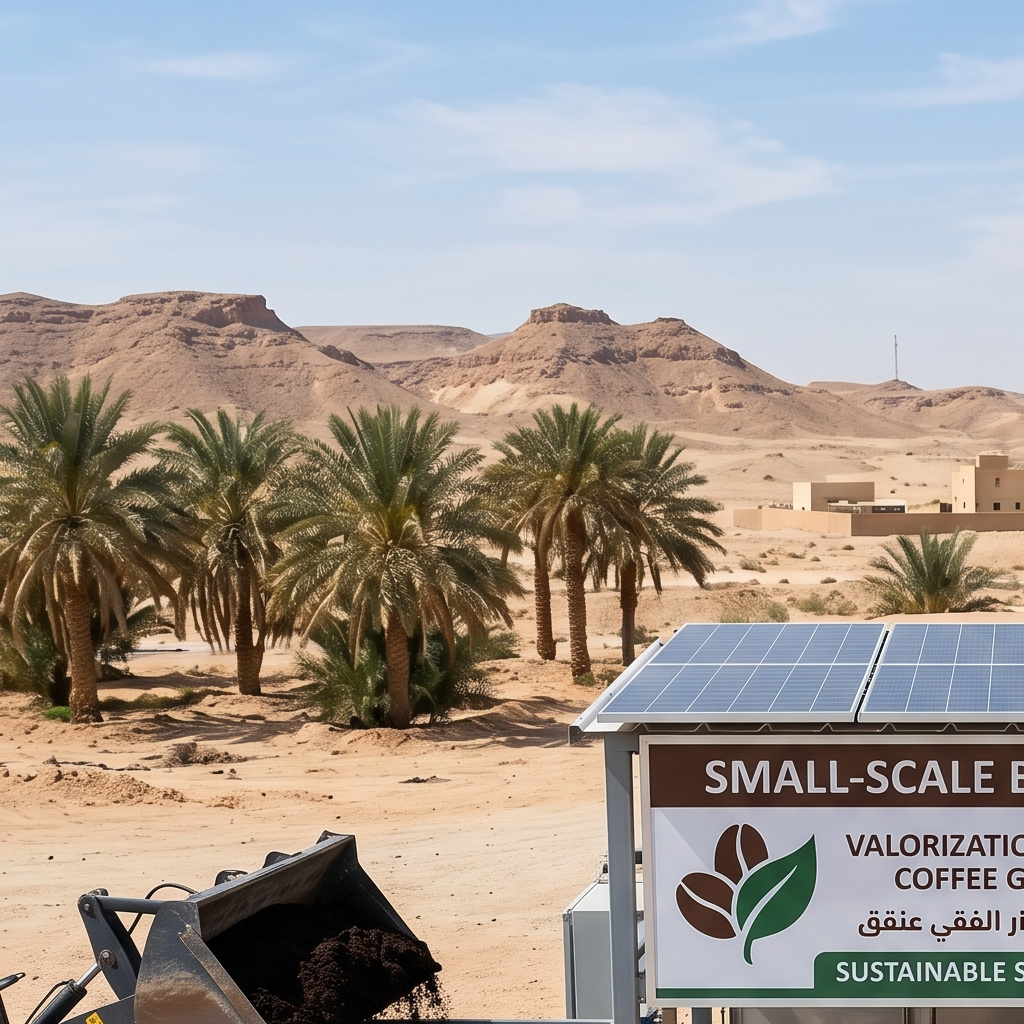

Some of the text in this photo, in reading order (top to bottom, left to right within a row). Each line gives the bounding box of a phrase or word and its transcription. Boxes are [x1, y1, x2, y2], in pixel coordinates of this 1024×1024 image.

[705, 759, 995, 794] SMALL-SCALE
[894, 867, 998, 890] COFFEE
[836, 961, 1006, 983] SUSTAINABLE
